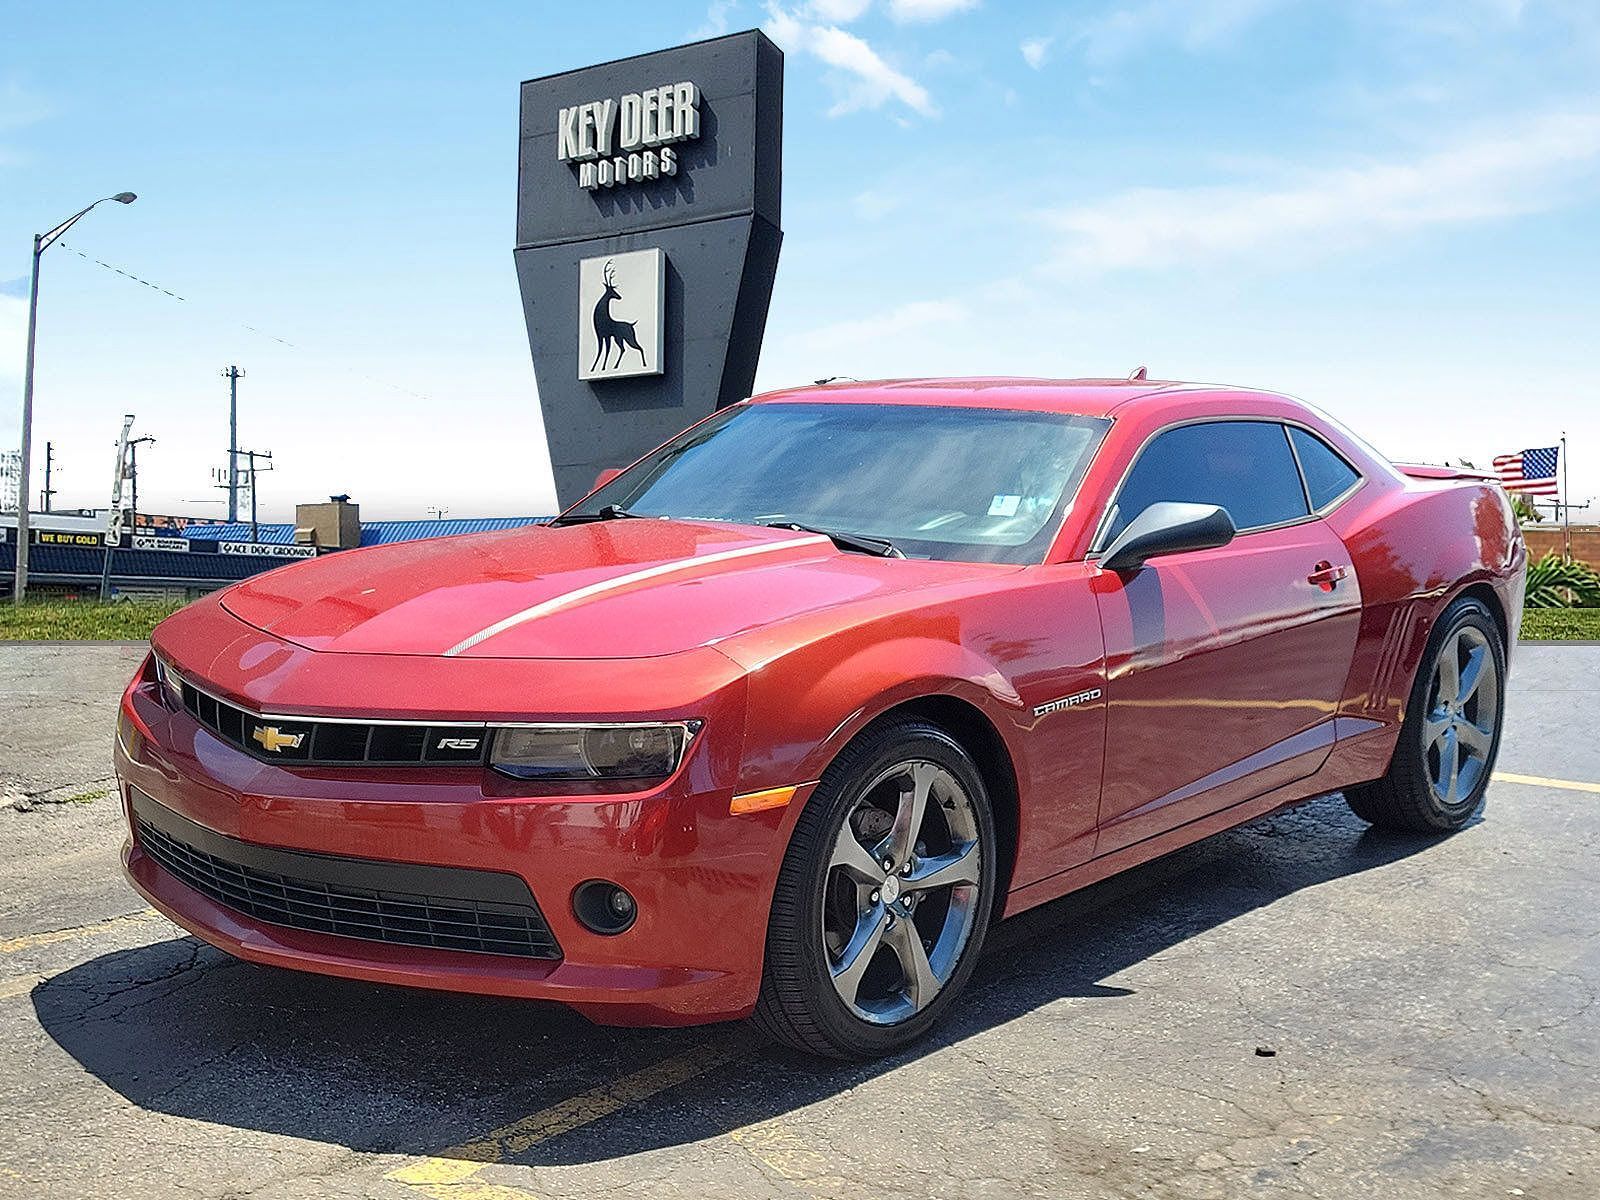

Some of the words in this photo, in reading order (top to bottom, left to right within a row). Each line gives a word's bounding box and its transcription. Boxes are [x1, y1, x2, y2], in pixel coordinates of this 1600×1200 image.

[558, 99, 617, 160] KEY
[620, 81, 699, 151] DEER
[580, 147, 676, 190] MOTORS
[41, 533, 55, 543] WE
[57, 534, 74, 543] BUY
[76, 535, 98, 545] GOLD
[233, 544, 247, 554] ACE
[251, 545, 270, 555] DOG
[273, 547, 315, 557] GROOMING
[1033, 688, 1102, 717] CAMARO
[437, 738, 480, 750] RS
